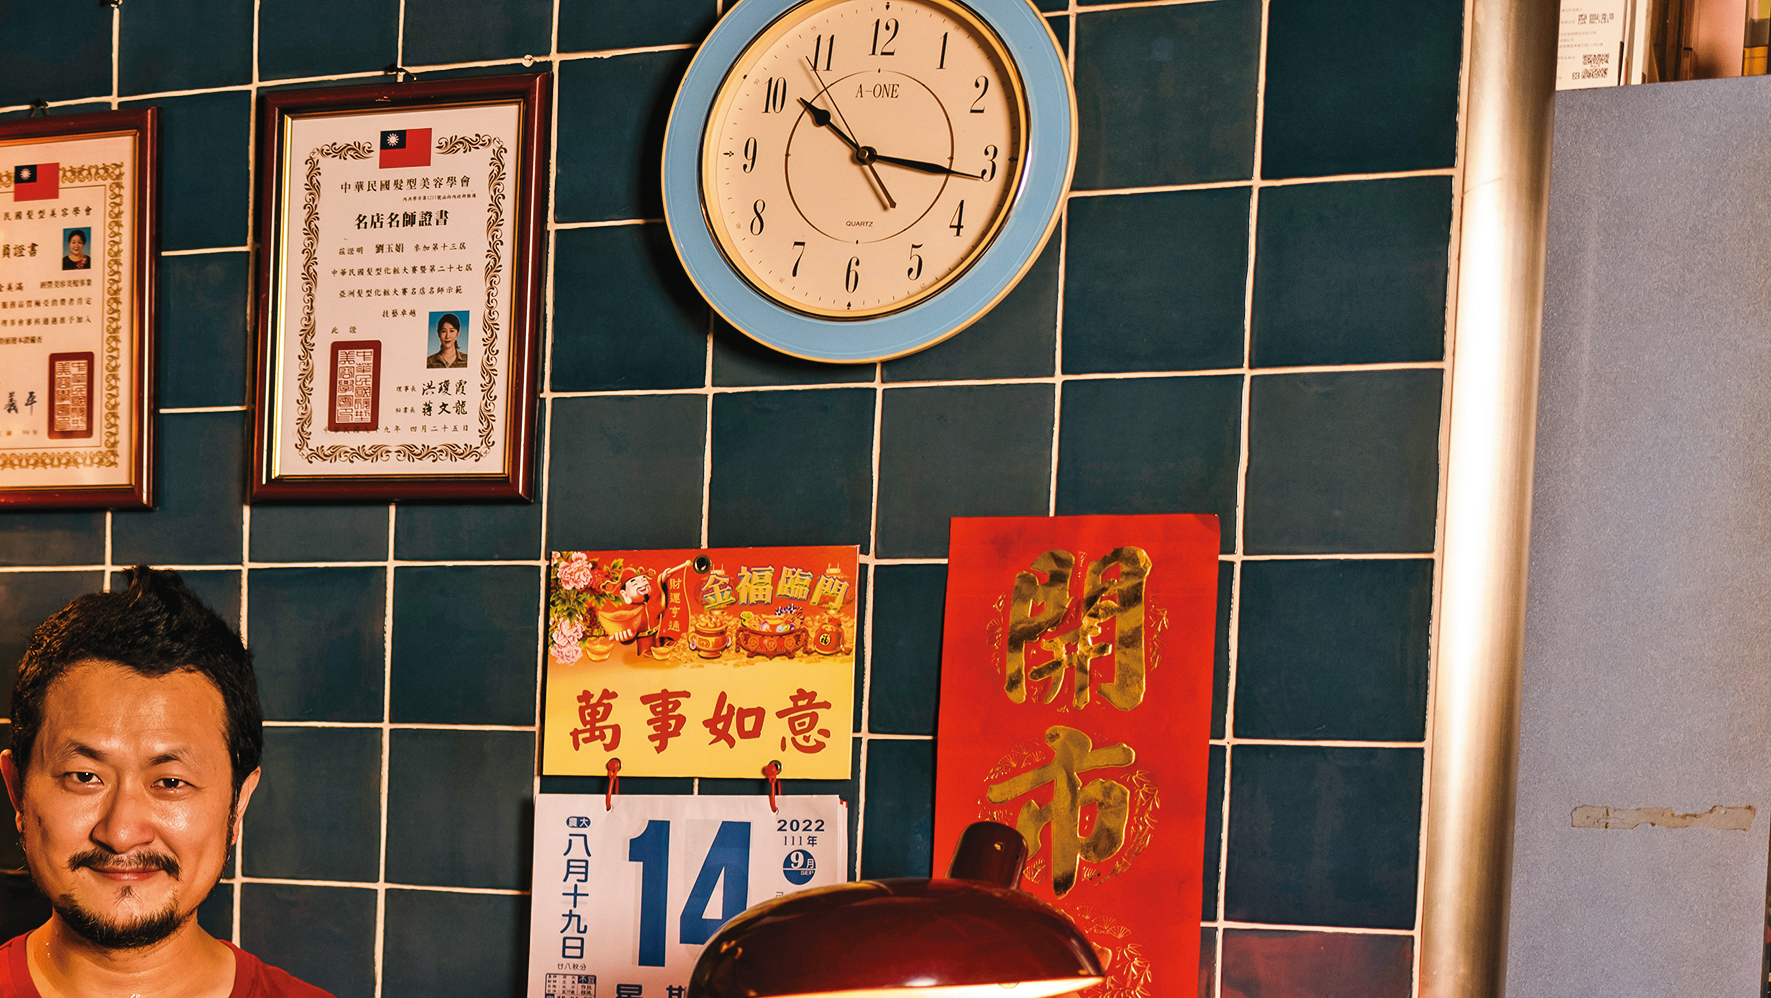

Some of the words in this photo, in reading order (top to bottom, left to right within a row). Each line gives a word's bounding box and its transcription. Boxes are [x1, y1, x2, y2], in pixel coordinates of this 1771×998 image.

[810, 33, 836, 72] 11
[868, 18, 900, 57] 12
[936, 31, 949, 70] 1
[761, 76, 788, 114] 10
[855, 83, 901, 99] A-ONE
[970, 75, 990, 114] 2
[742, 136, 758, 174] 9
[980, 144, 999, 183] 3
[340, 174, 471, 194] 中華民國髮型美容學會
[354, 209, 450, 230] 名店名師證書
[749, 198, 766, 236] 8
[845, 220, 874, 229] QUARTZ
[949, 199, 966, 238] 4
[791, 241, 807, 278] 7
[844, 256, 860, 294] 6
[907, 243, 924, 281] 5
[668, 577, 682, 633] 財運亨通
[700, 564, 850, 612] 金福臨門
[569, 688, 832, 754] 萬事如意
[777, 819, 825, 832] 2022
[783, 835, 818, 847] 111年
[560, 833, 592, 960] 八月十九日
[628, 819, 753, 968] 14
